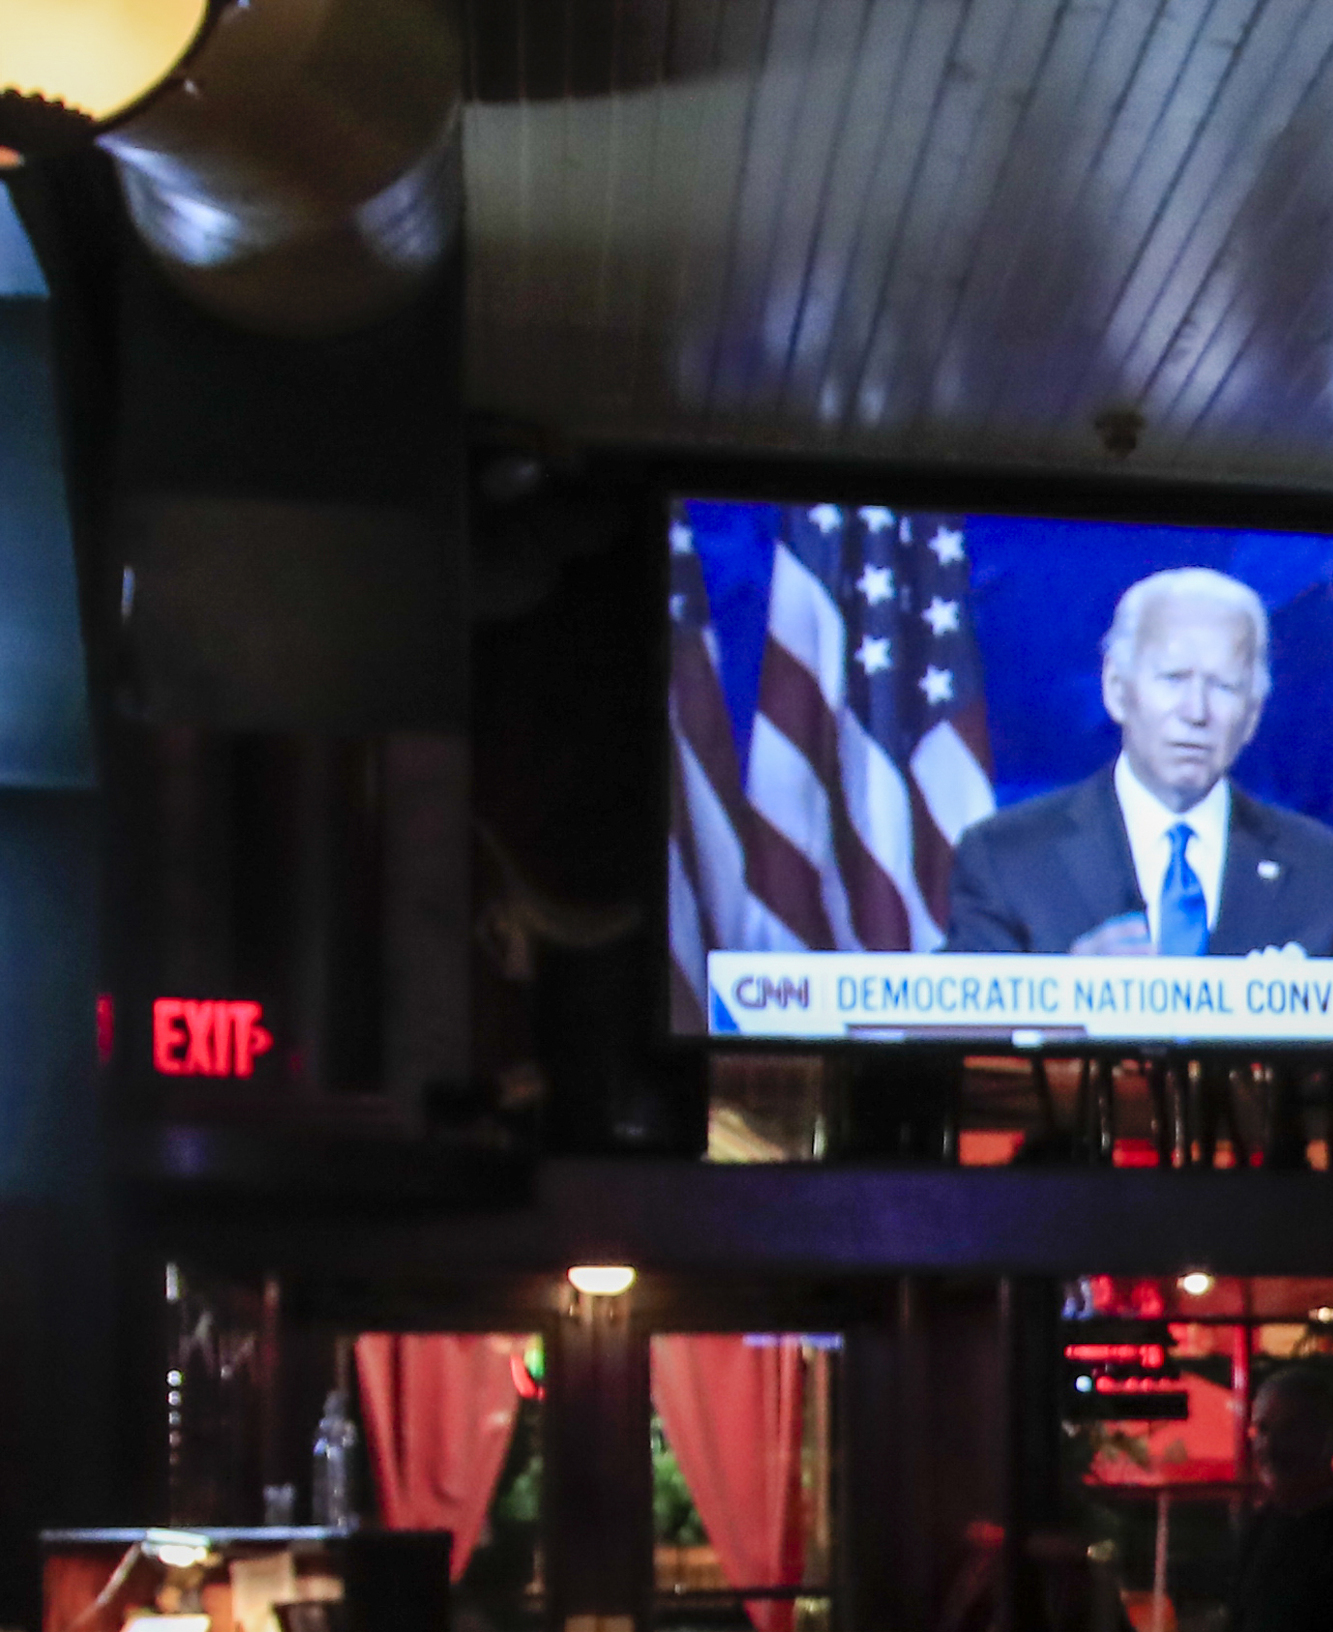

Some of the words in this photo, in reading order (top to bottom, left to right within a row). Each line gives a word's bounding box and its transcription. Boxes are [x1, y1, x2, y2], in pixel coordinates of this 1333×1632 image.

[735, 975, 810, 1010] CNN
[836, 976, 1059, 1013] DEMOCRATIC
[1073, 978, 1234, 1014] NATIONAL
[153, 997, 264, 1080] EXIT
